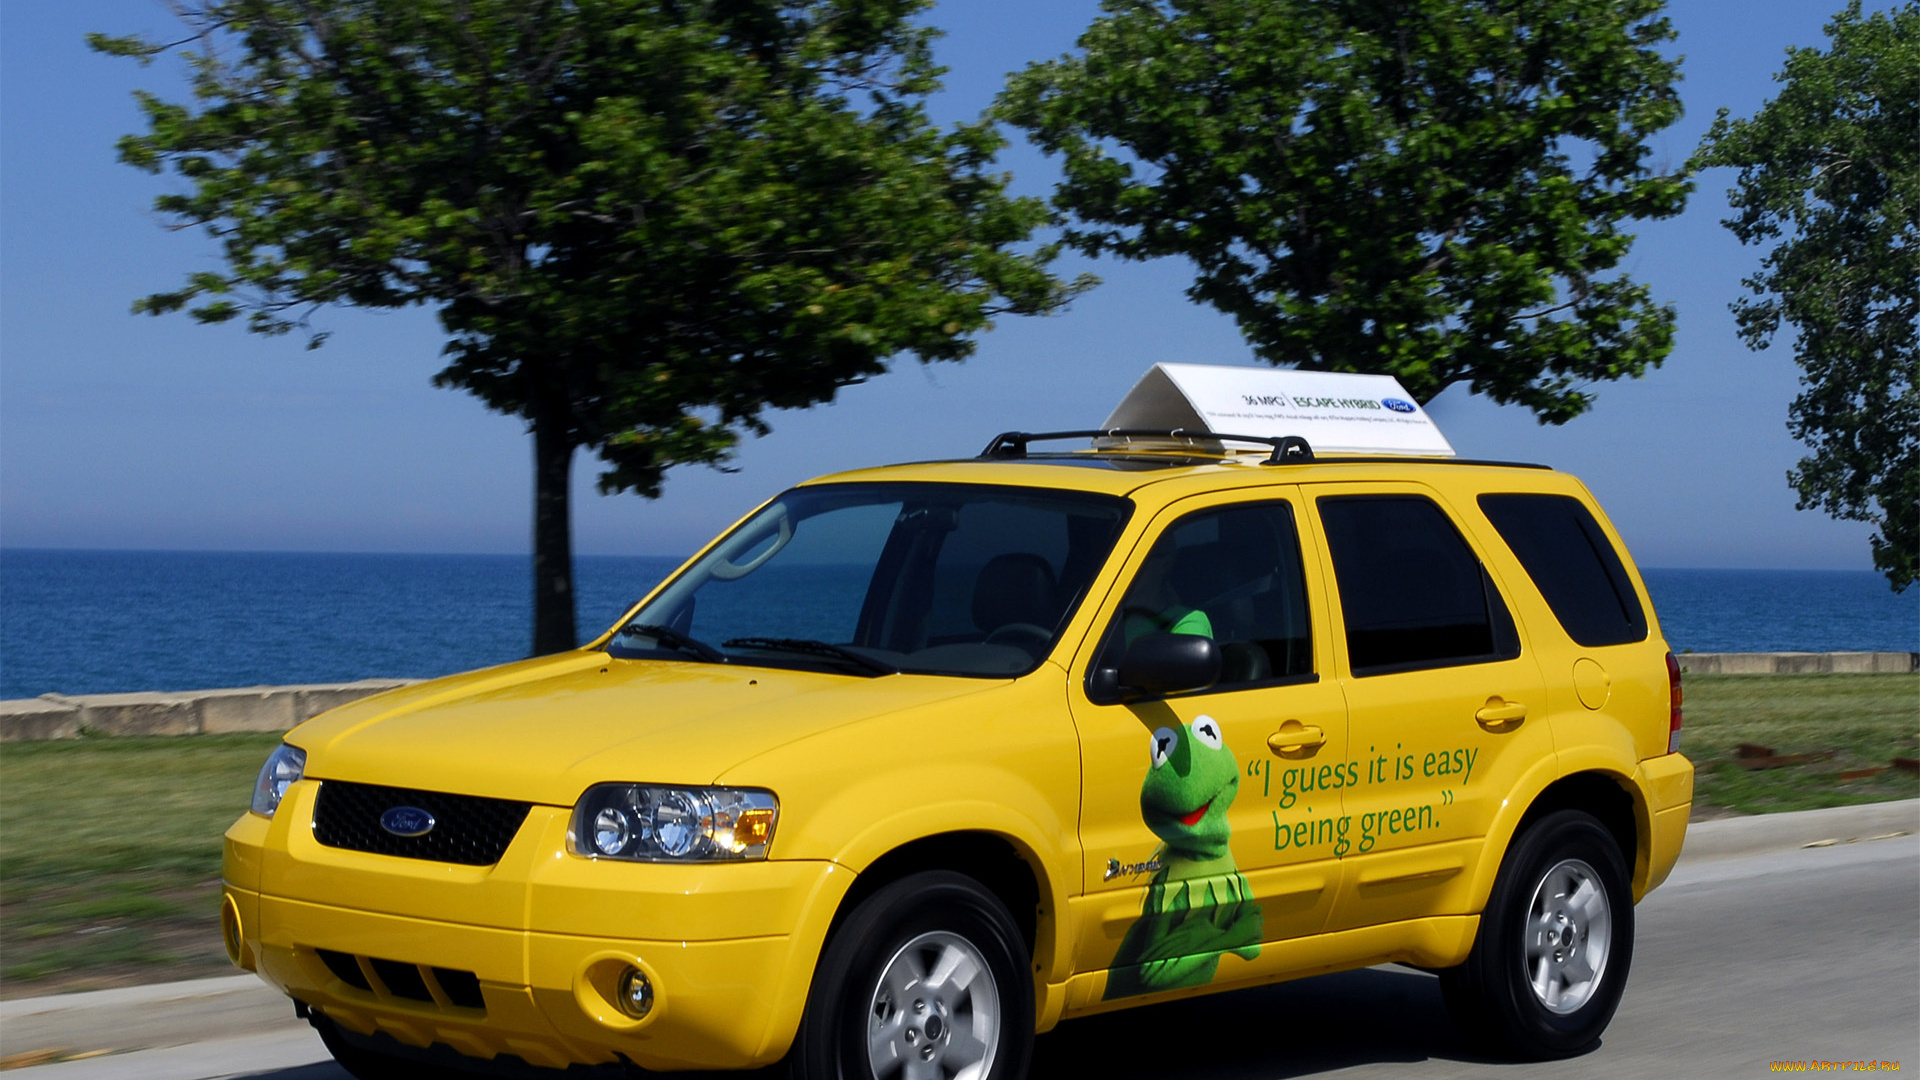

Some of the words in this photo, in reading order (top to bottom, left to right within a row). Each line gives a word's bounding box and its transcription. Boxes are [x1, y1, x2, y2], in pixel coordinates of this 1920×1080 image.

[1242, 394, 1257, 406] 36
[1257, 396, 1285, 407] MPG
[1293, 397, 1339, 409] ESCAPE
[1339, 398, 1381, 410] HYBRID
[1386, 398, 1412, 412] Ford
[1279, 761, 1359, 809] guess
[1368, 745, 1388, 785] it
[1395, 742, 1415, 781] is
[1423, 747, 1479, 786] easy
[389, 810, 425, 832] Ford
[1272, 806, 1352, 856] being
